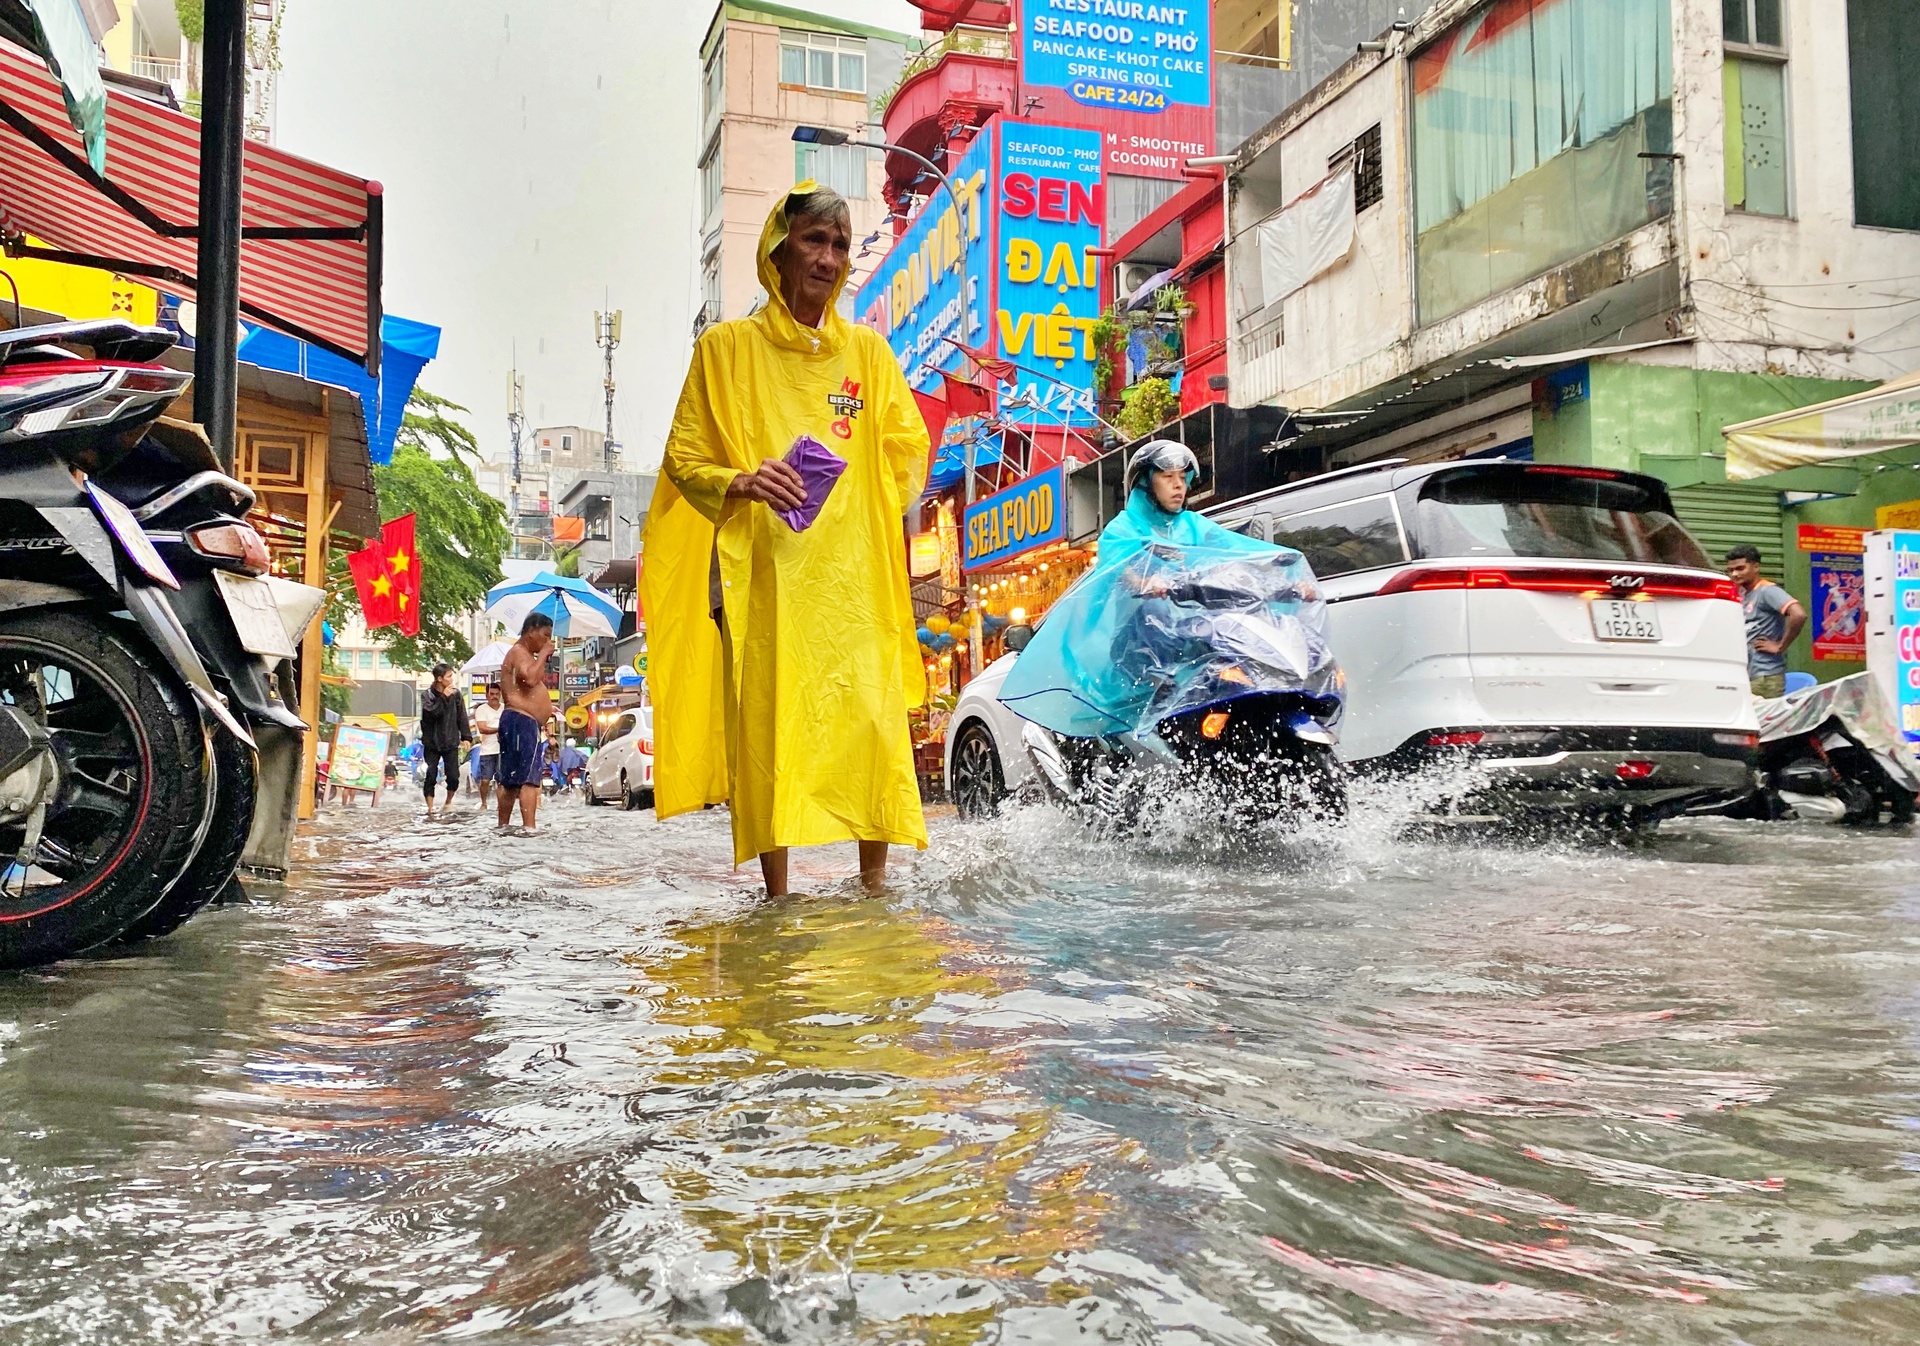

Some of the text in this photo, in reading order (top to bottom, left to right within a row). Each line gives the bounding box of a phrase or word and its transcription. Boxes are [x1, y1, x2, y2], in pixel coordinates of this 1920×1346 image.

[1050, 0, 1188, 26] RESTAURANT
[1034, 16, 1134, 44] SEAFOOD
[1155, 30, 1199, 53] PHỞ
[1033, 39, 1204, 75] PANCAKE-KHOT CAKE
[1068, 62, 1173, 89] SPRING ROLL
[1073, 82, 1165, 109] CAFE 24/24
[1008, 141, 1065, 157] SEAFOOD
[1130, 135, 1206, 156] SMOOTHIE
[1008, 155, 1100, 174] RESTAURANT CAFE
[1110, 150, 1179, 170] COCONUT
[1002, 172, 1102, 227] SEN
[1005, 238, 1097, 294] ĐẠI
[996, 302, 1101, 370] VIỆT
[1001, 379, 1098, 414] 24/24
[1562, 381, 1583, 400] 224
[834, 405, 858, 420] ICE
[968, 483, 1054, 560] SEAFOOD
[1611, 602, 1639, 619] 51K
[1605, 621, 1655, 637] 162.82
[565, 676, 589, 685] GS25
